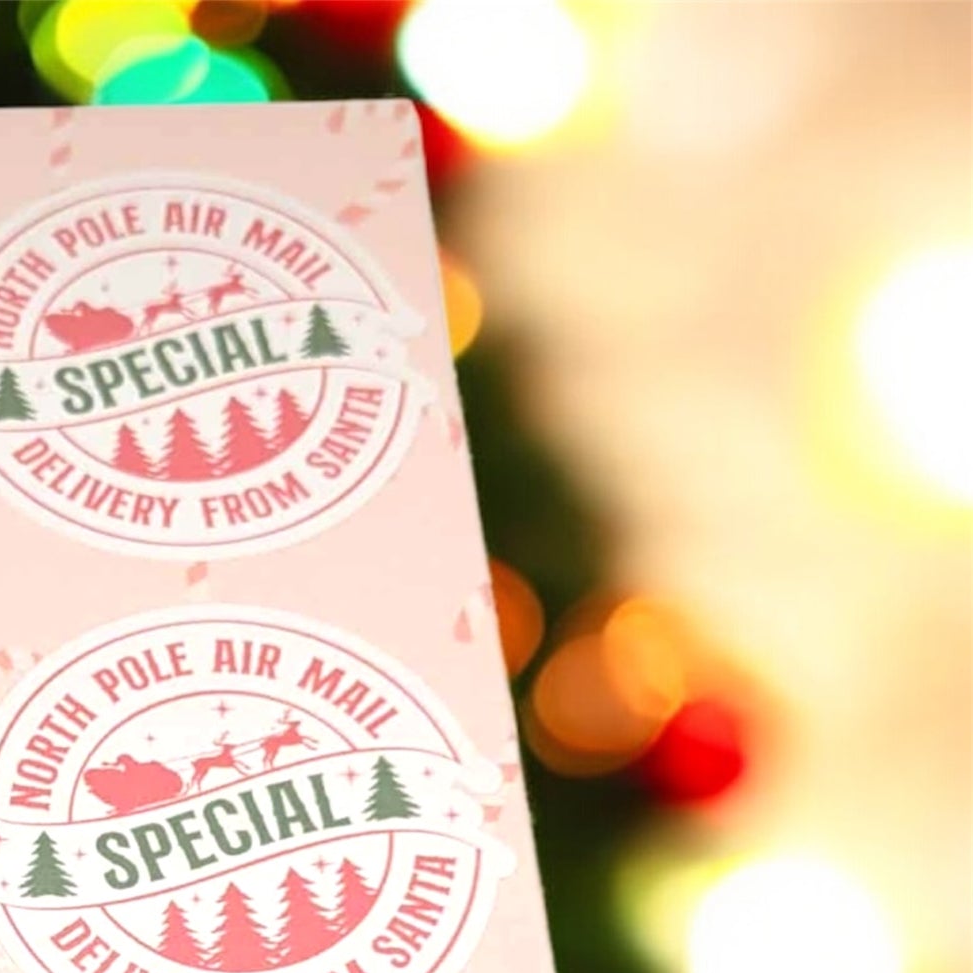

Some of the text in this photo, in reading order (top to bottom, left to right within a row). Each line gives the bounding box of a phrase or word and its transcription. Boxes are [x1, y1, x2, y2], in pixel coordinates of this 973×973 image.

[52, 204, 145, 258] POLE
[163, 202, 228, 237] AIR
[242, 219, 335, 291] MAIL
[54, 318, 288, 415] SPECIAL
[12, 385, 384, 528] DELIVERY FROM SANTA
[9, 639, 398, 810] NORTH POLE AIR MAIL
[95, 773, 351, 890] SPECIAL
[372, 854, 457, 968] SANTA
